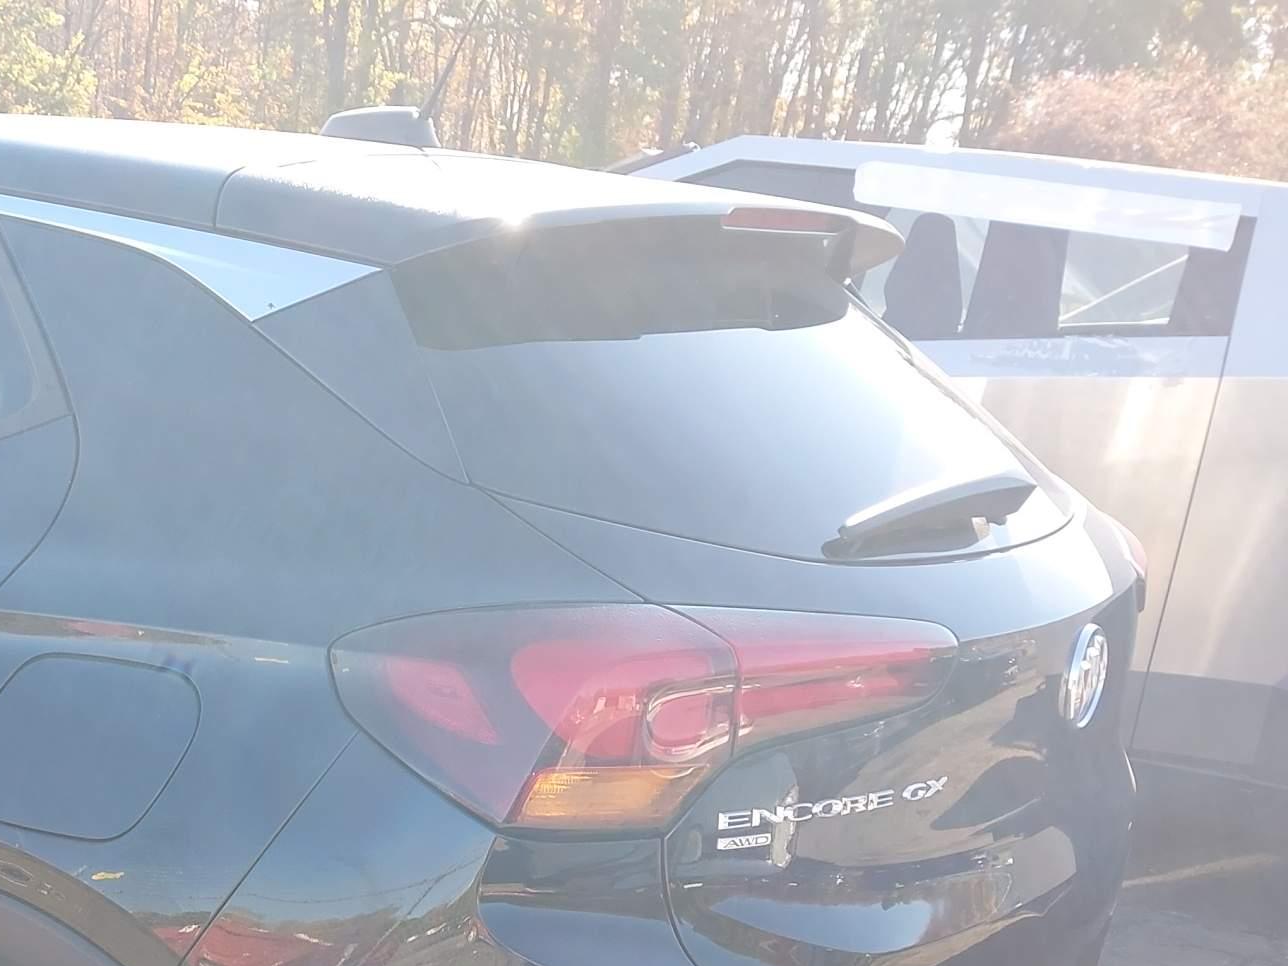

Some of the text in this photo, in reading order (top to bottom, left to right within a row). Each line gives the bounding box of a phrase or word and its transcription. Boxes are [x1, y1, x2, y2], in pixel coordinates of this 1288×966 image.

[717, 776, 949, 831] ENCORE GX
[721, 834, 771, 849] AWD
